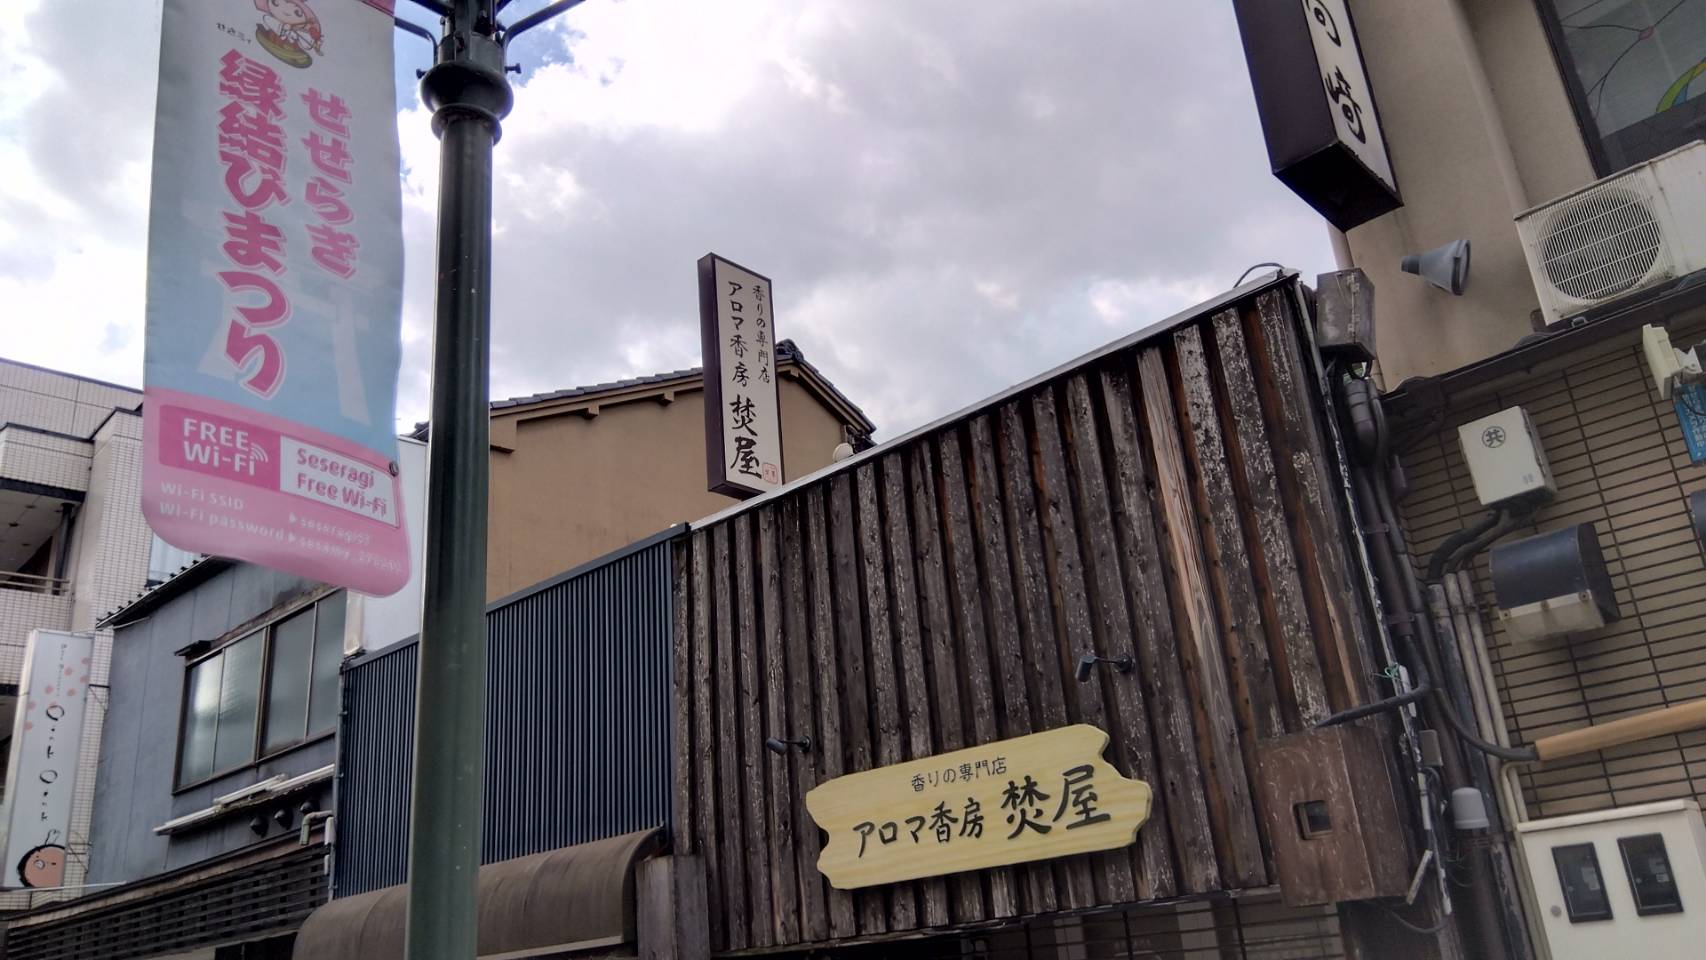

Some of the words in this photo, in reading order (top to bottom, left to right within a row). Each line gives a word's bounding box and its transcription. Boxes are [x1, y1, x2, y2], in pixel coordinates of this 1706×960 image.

[301, 87, 361, 280] せせらぎ
[218, 48, 291, 398] 縁結びまつり
[728, 281, 750, 388] アロマ香房
[753, 284, 770, 384] 香りの専門店
[184, 418, 249, 450] FREE
[729, 394, 763, 480] 焚屋
[184, 442, 256, 476] Wi-Fi
[297, 448, 375, 489] Seseragi
[161, 480, 204, 500] Wi-Fi
[209, 491, 243, 511] SSID
[297, 472, 338, 499] Free
[342, 489, 387, 516] Wi-Fi
[160, 501, 203, 521] Wi-Fi
[209, 514, 284, 542] password
[911, 757, 1007, 792] 香りの専門店
[852, 797, 985, 858] アロマ香房
[1000, 764, 1111, 840] 焚屋
